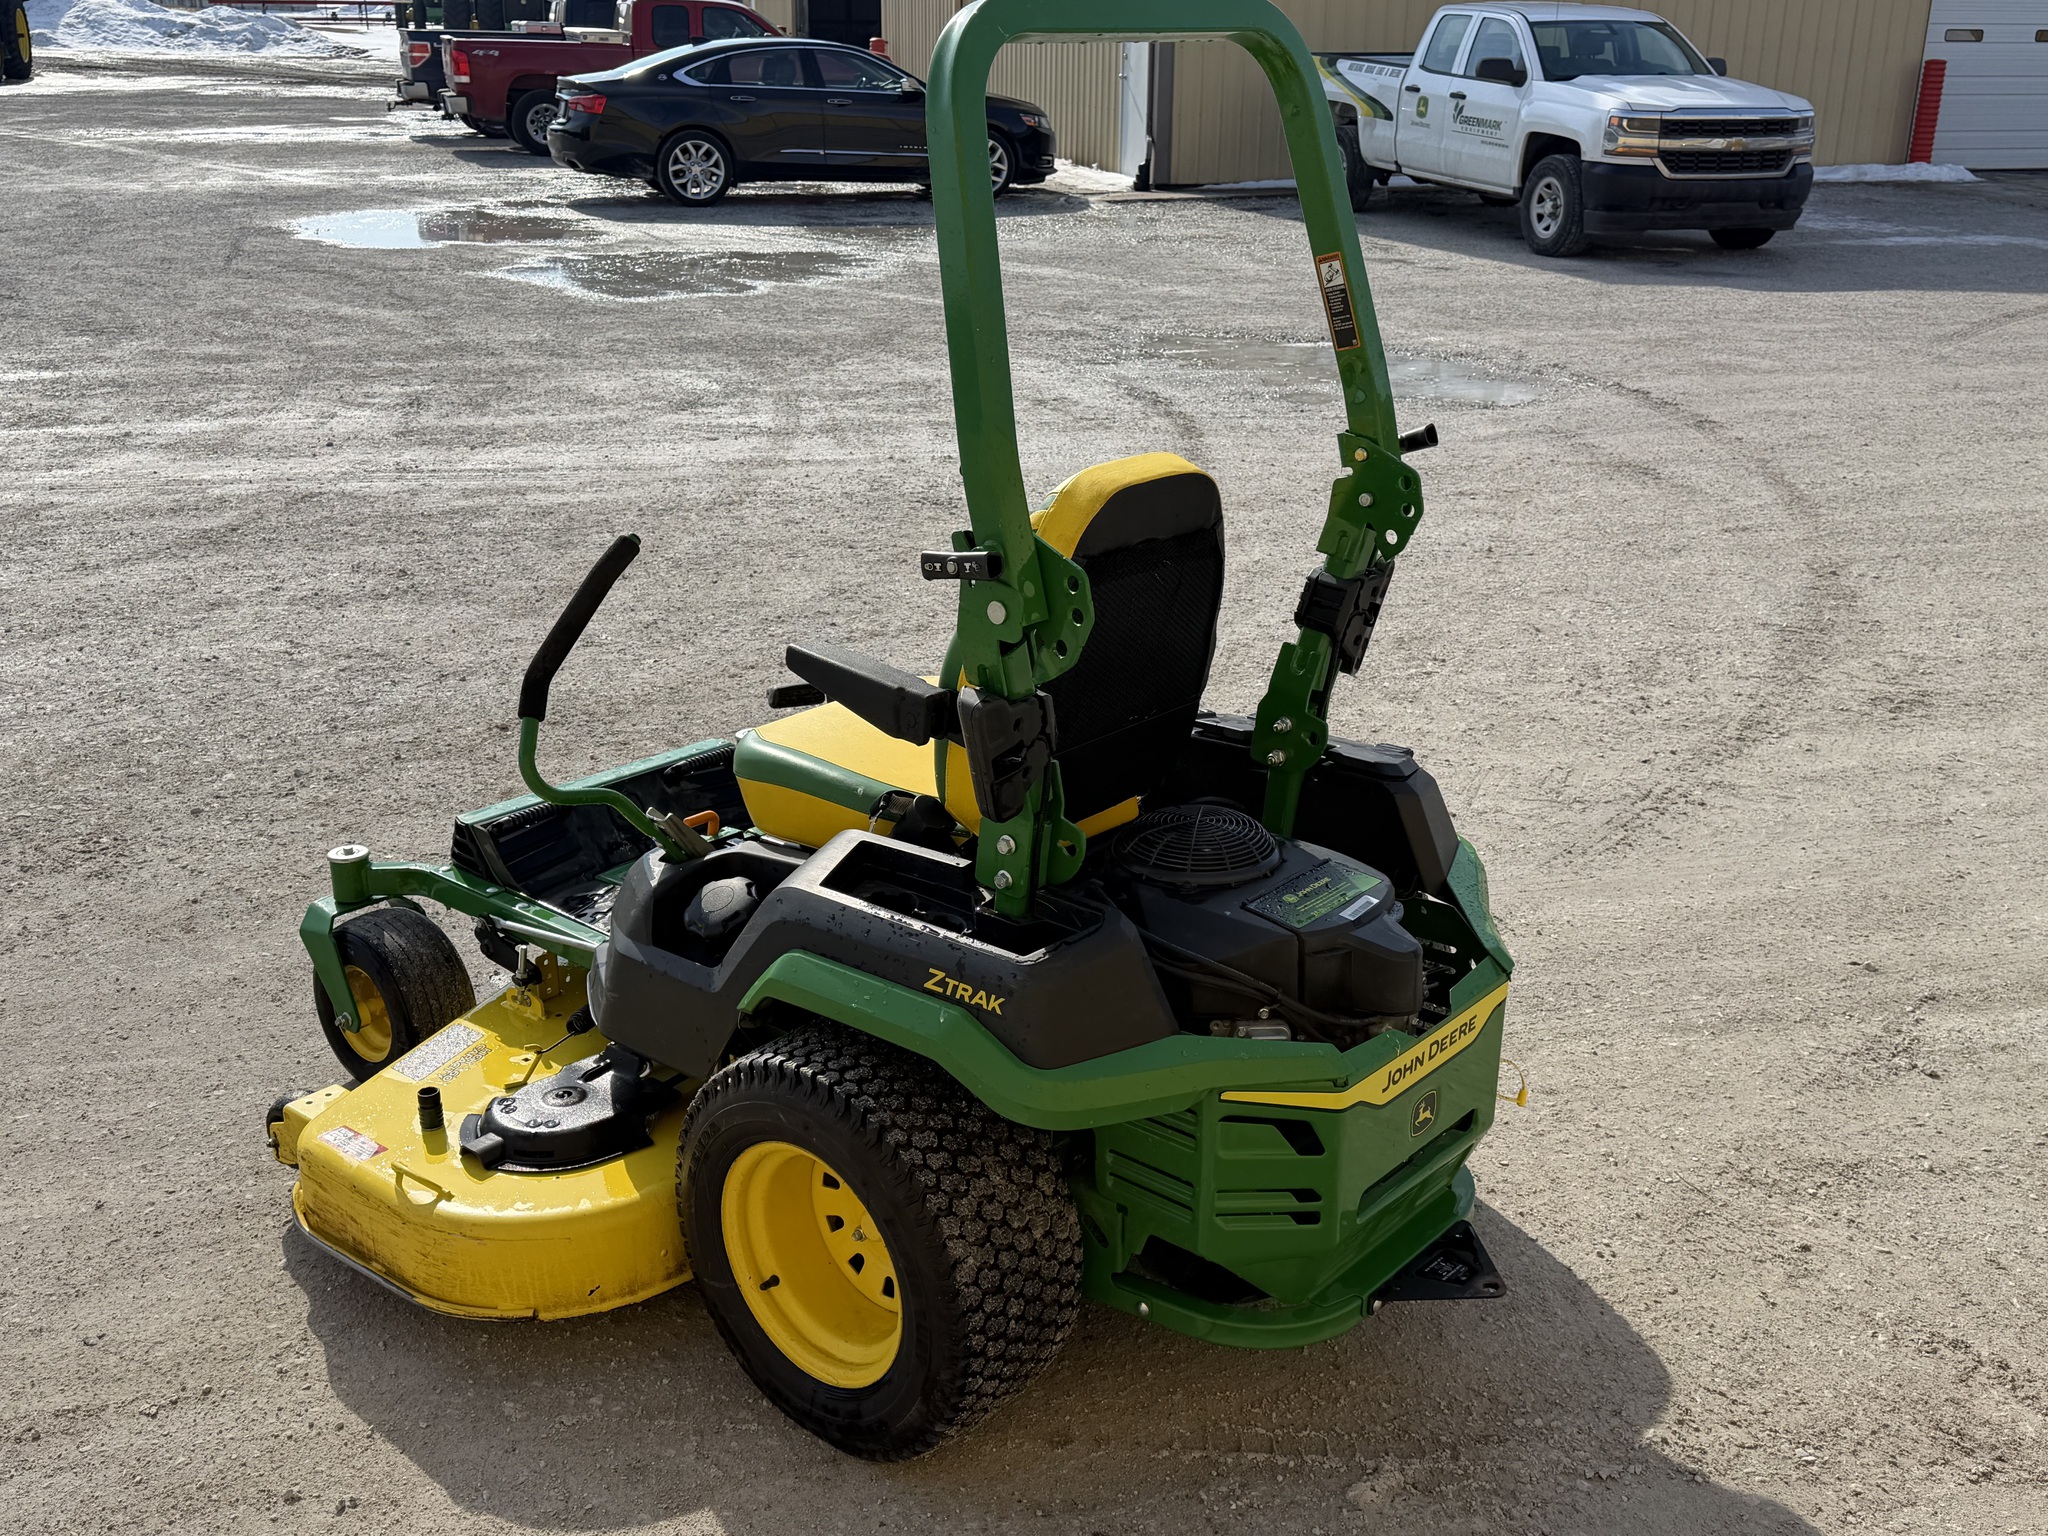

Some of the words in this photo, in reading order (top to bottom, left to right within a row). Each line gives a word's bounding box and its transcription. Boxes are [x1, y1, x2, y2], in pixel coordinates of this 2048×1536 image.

[1459, 115, 1503, 131] GREENMARK
[923, 967, 1006, 1016] ZTRAK
[1382, 1051, 1425, 1094] JOHN
[1428, 1014, 1477, 1062] DEERE
